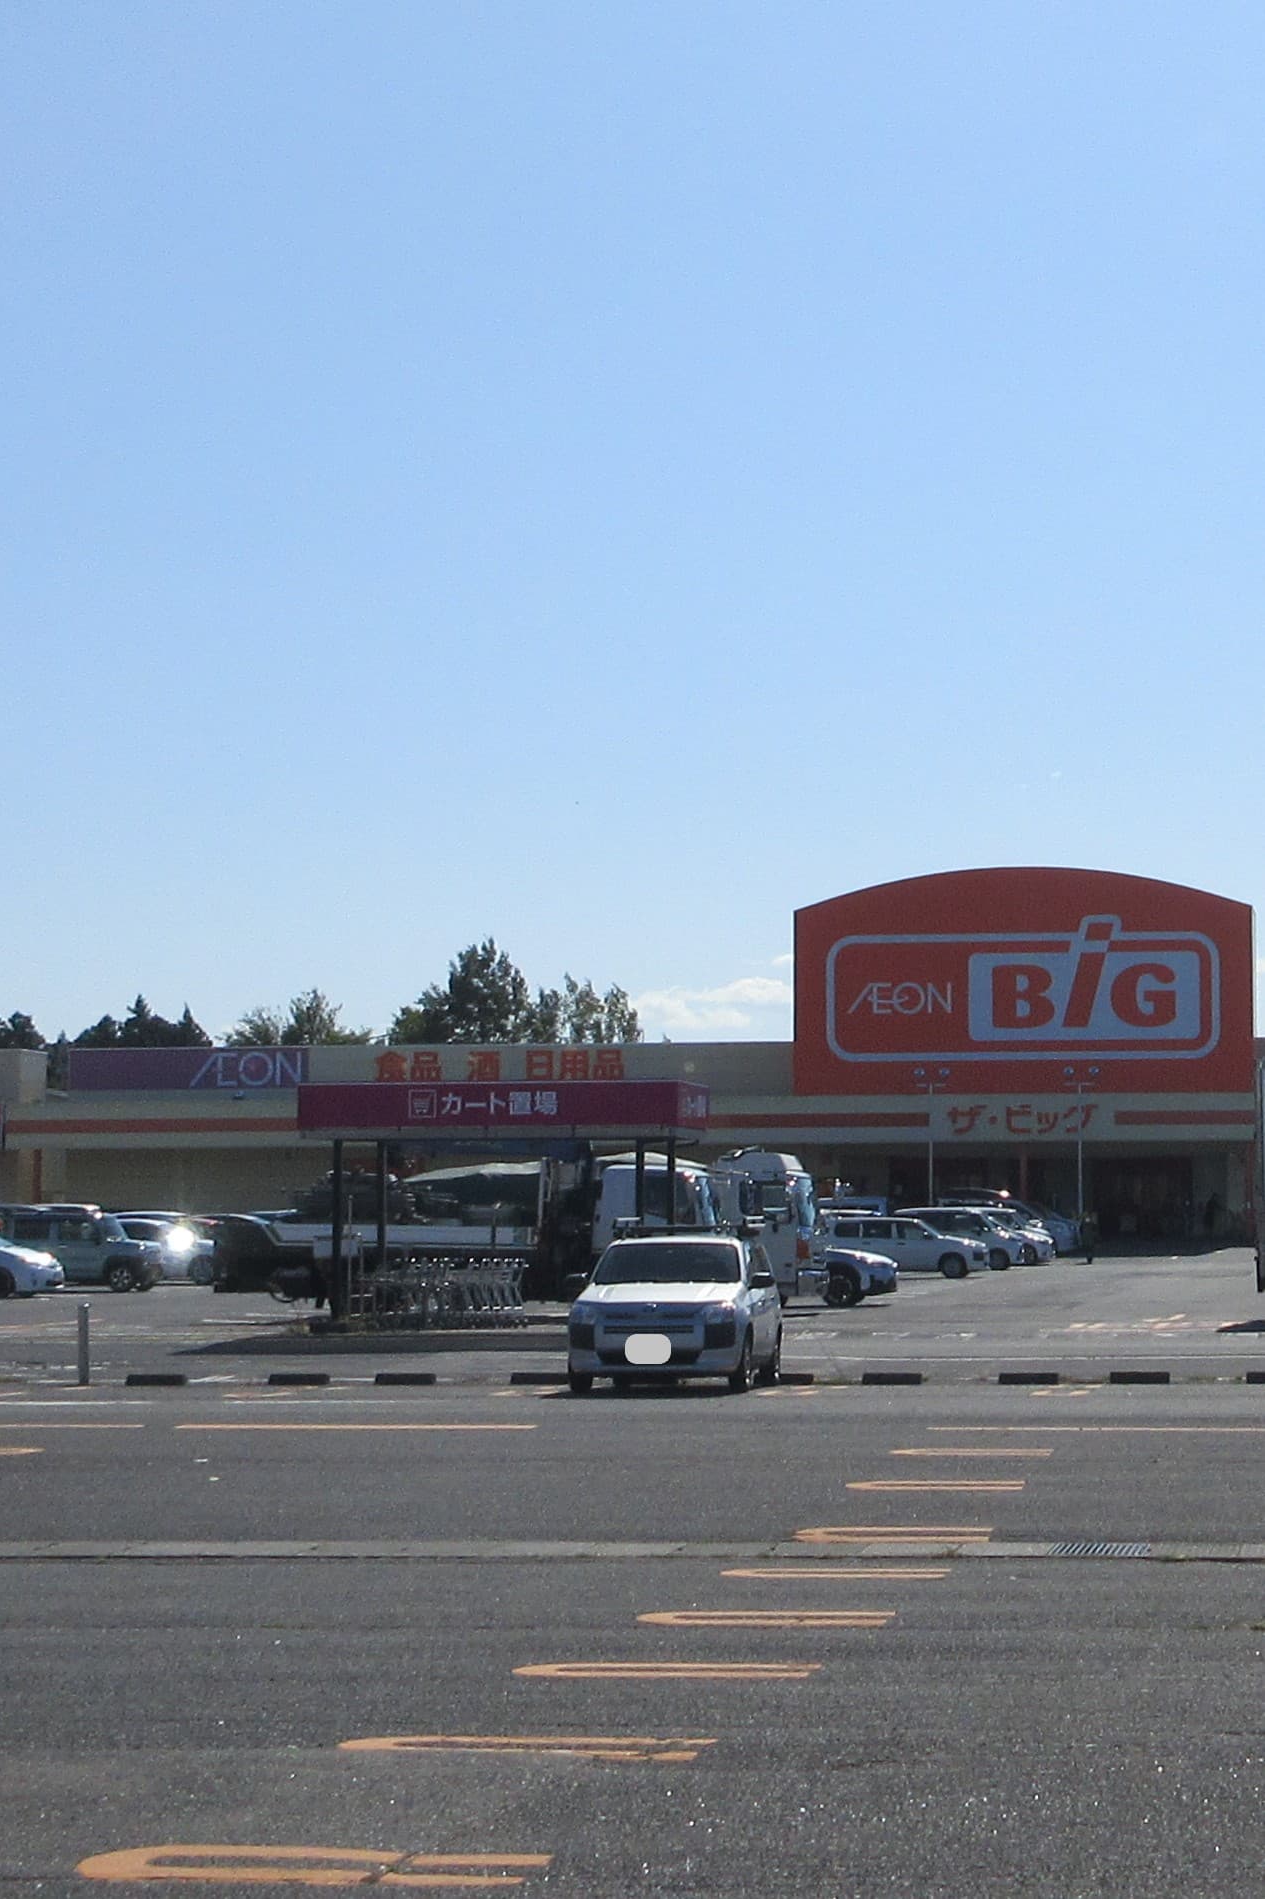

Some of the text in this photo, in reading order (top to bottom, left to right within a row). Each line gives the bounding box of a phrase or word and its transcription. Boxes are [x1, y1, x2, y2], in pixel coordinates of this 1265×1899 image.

[375, 1049, 625, 1081] 食品 酒 日用品
[441, 1091, 559, 1115] カート置場
[947, 1104, 1099, 1135] ザ・ビッグ
